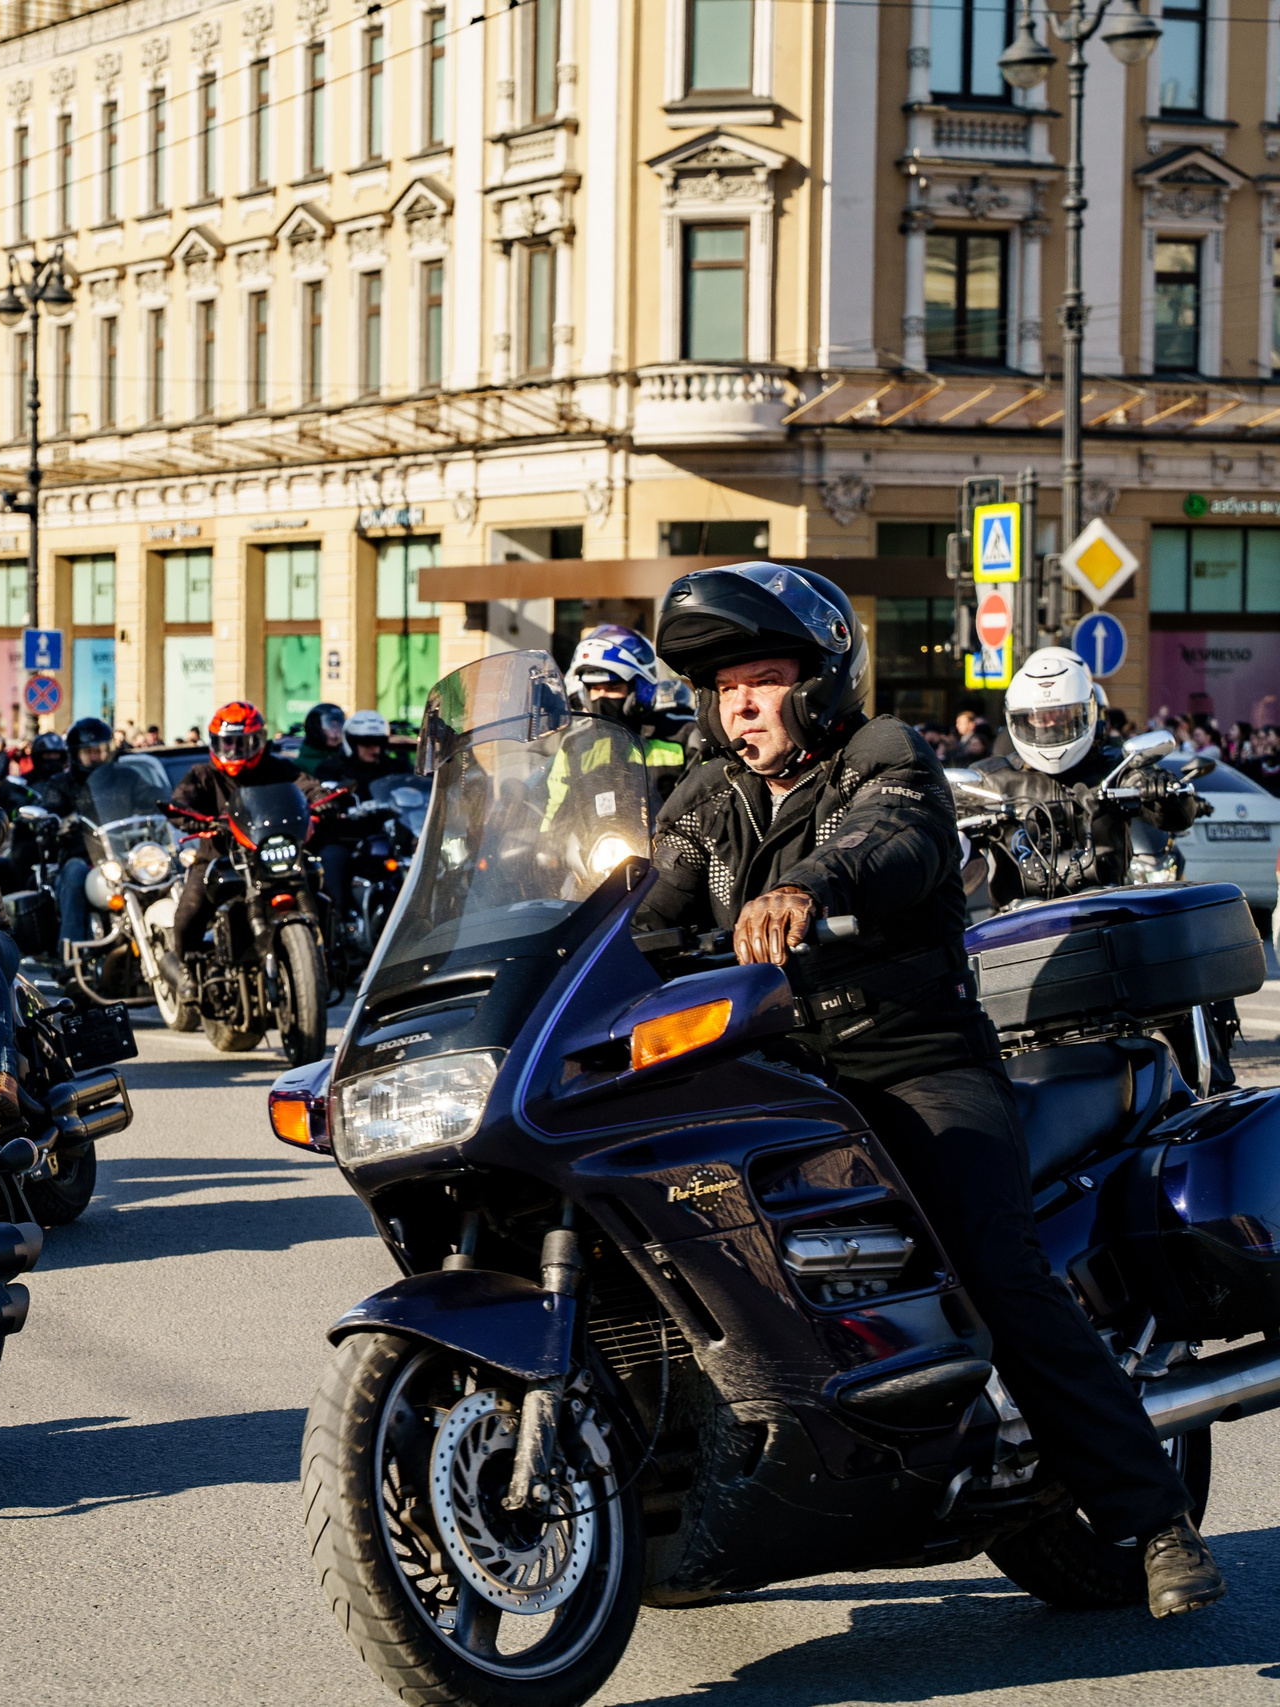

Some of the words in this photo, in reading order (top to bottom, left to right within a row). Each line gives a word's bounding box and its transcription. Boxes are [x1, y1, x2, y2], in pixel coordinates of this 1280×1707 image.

[1211, 496, 1258, 518] азбука
[881, 785, 922, 801] rukka
[374, 1032, 433, 1053] HONDA
[667, 1180, 740, 1202] Pan-European
